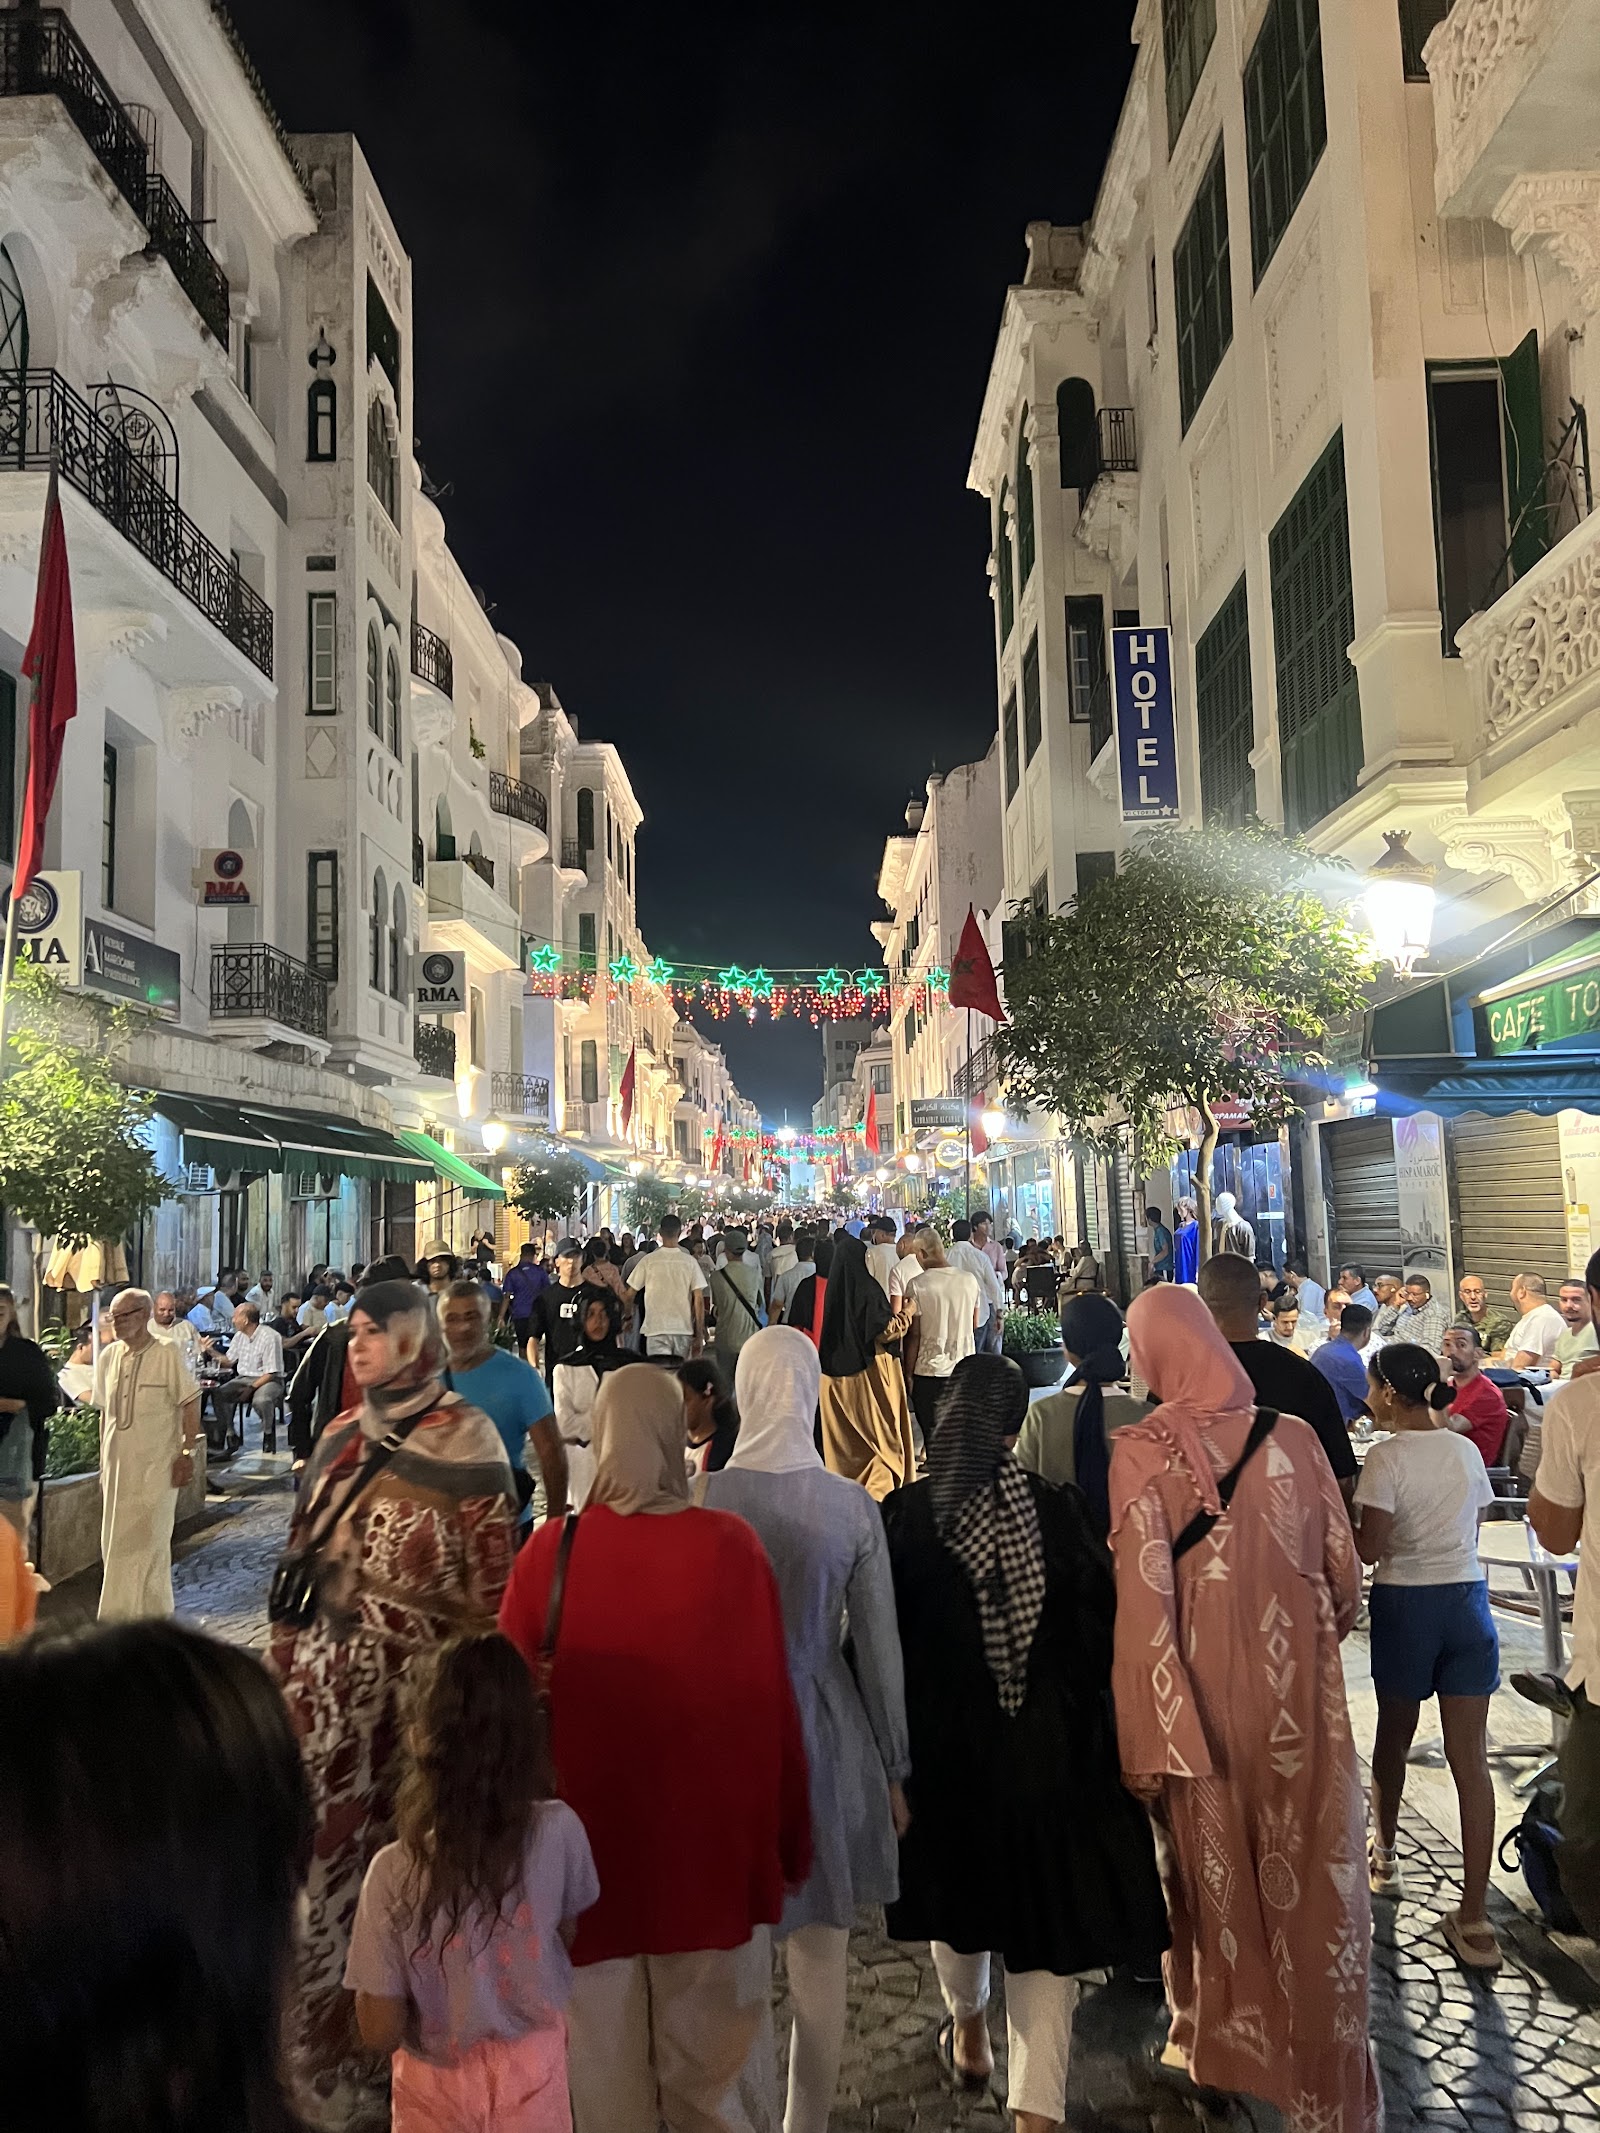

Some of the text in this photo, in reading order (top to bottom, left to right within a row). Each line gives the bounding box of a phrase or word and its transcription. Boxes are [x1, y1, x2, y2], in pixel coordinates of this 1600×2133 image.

[1129, 634, 1160, 804] HOTEL
[1124, 809, 1157, 817] VICTORIA
[205, 881, 249, 897] RMA
[417, 987, 460, 1002] RMA
[1490, 996, 1545, 1043] CAFE
[914, 1116, 939, 1125] LIBRAIRIE
[1564, 1126, 1600, 1137] IBERIA
